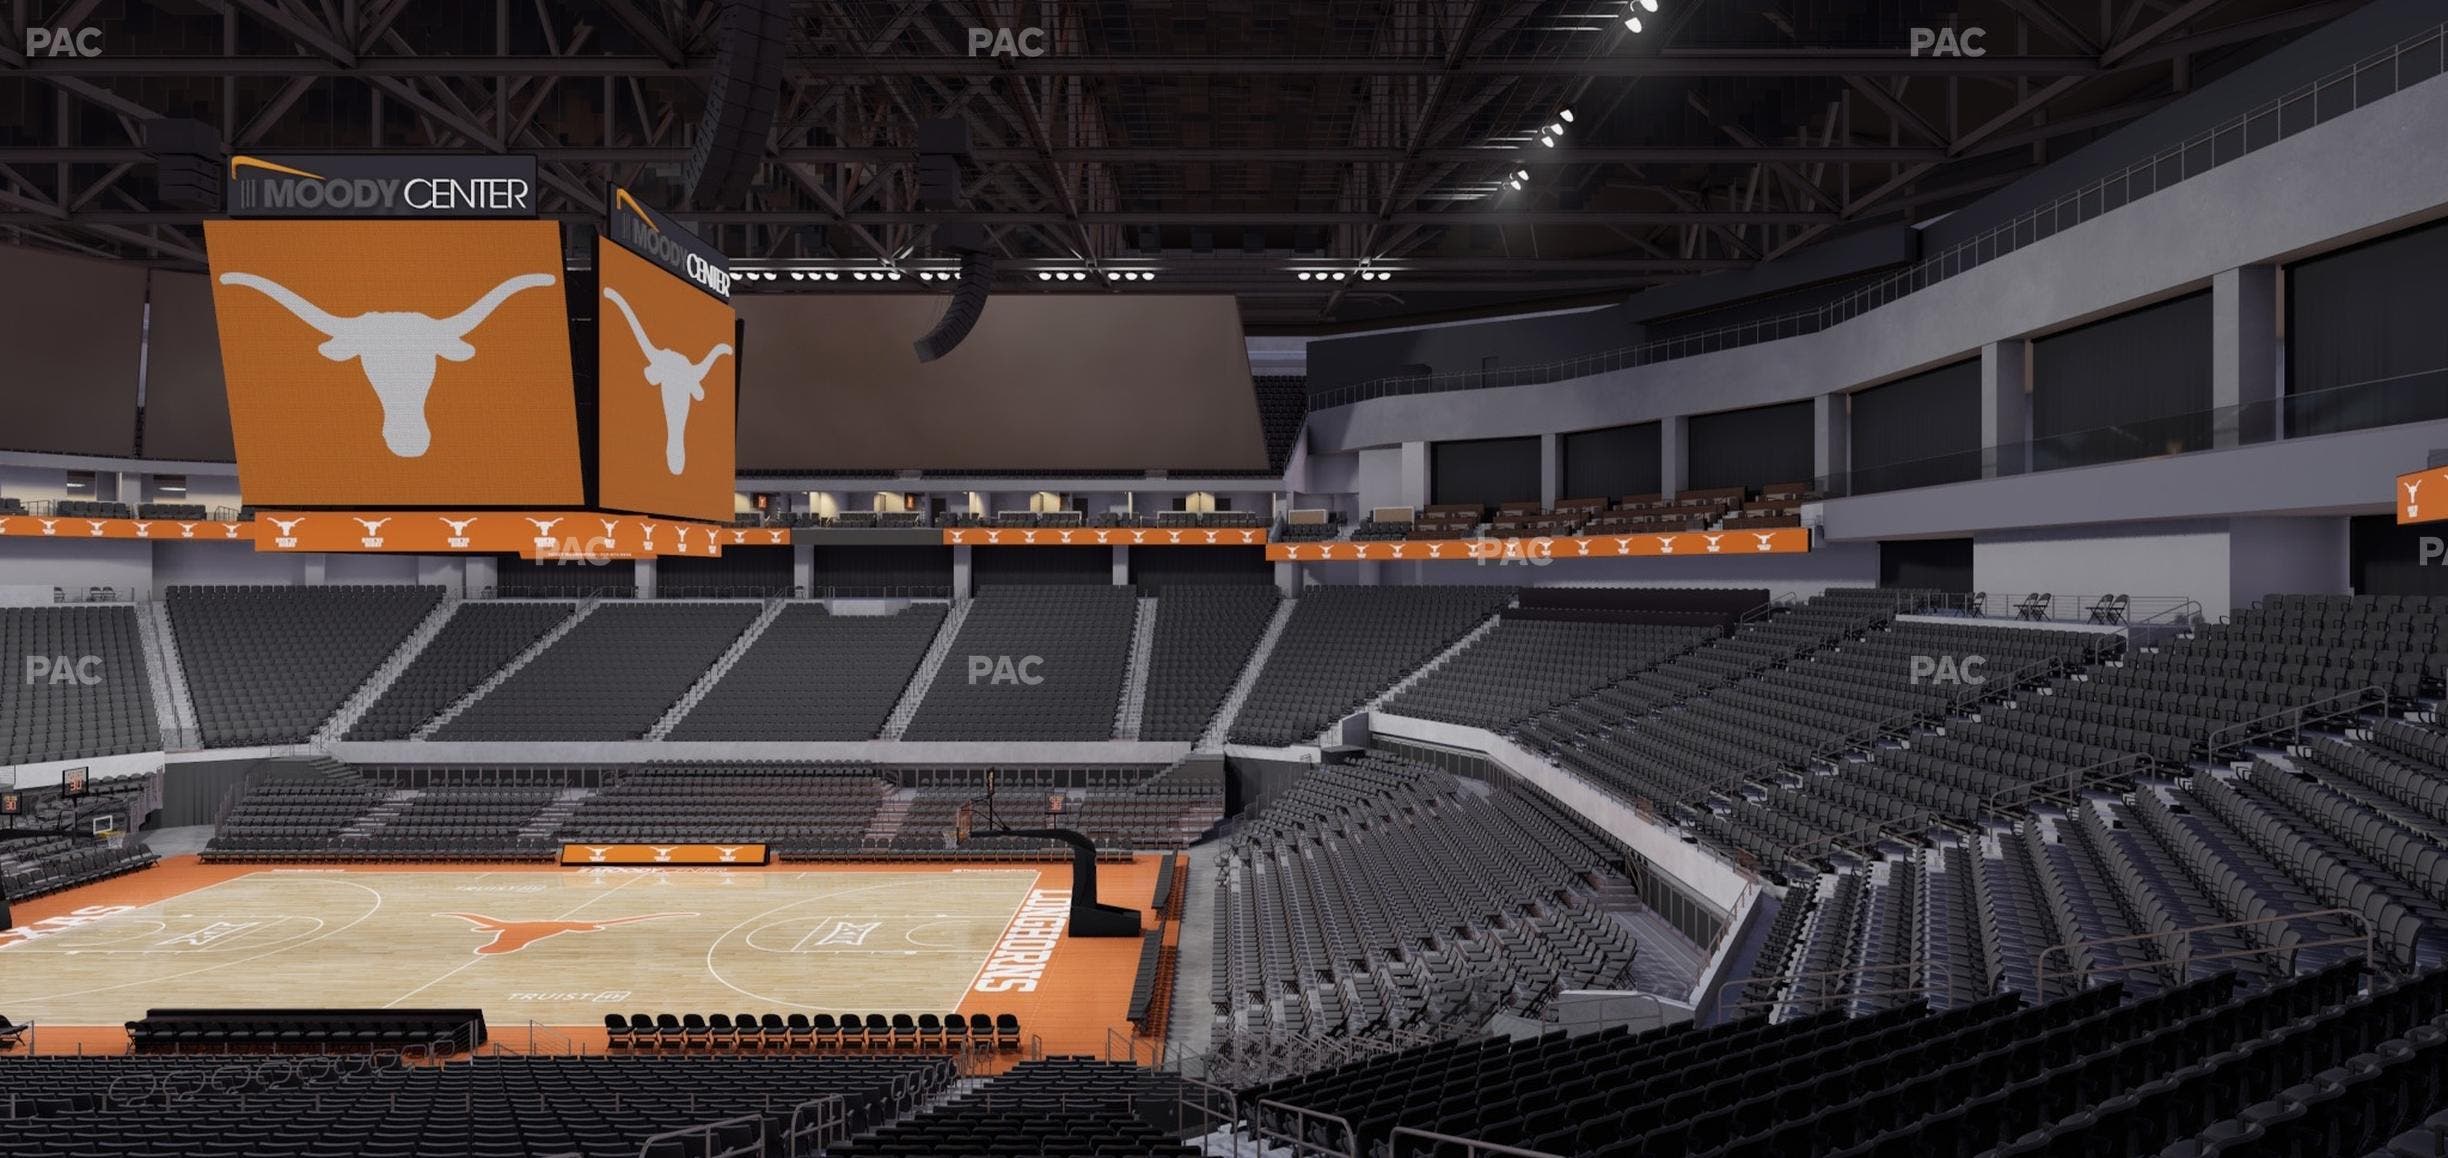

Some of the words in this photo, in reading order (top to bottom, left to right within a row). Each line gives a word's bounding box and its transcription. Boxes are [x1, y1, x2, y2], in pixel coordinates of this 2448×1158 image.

[263, 178, 400, 208] MOODY
[403, 178, 529, 209] CENTER
[631, 217, 688, 272] MOODY
[686, 252, 731, 298] CENTER
[974, 889, 1072, 992] LONGHORNS
